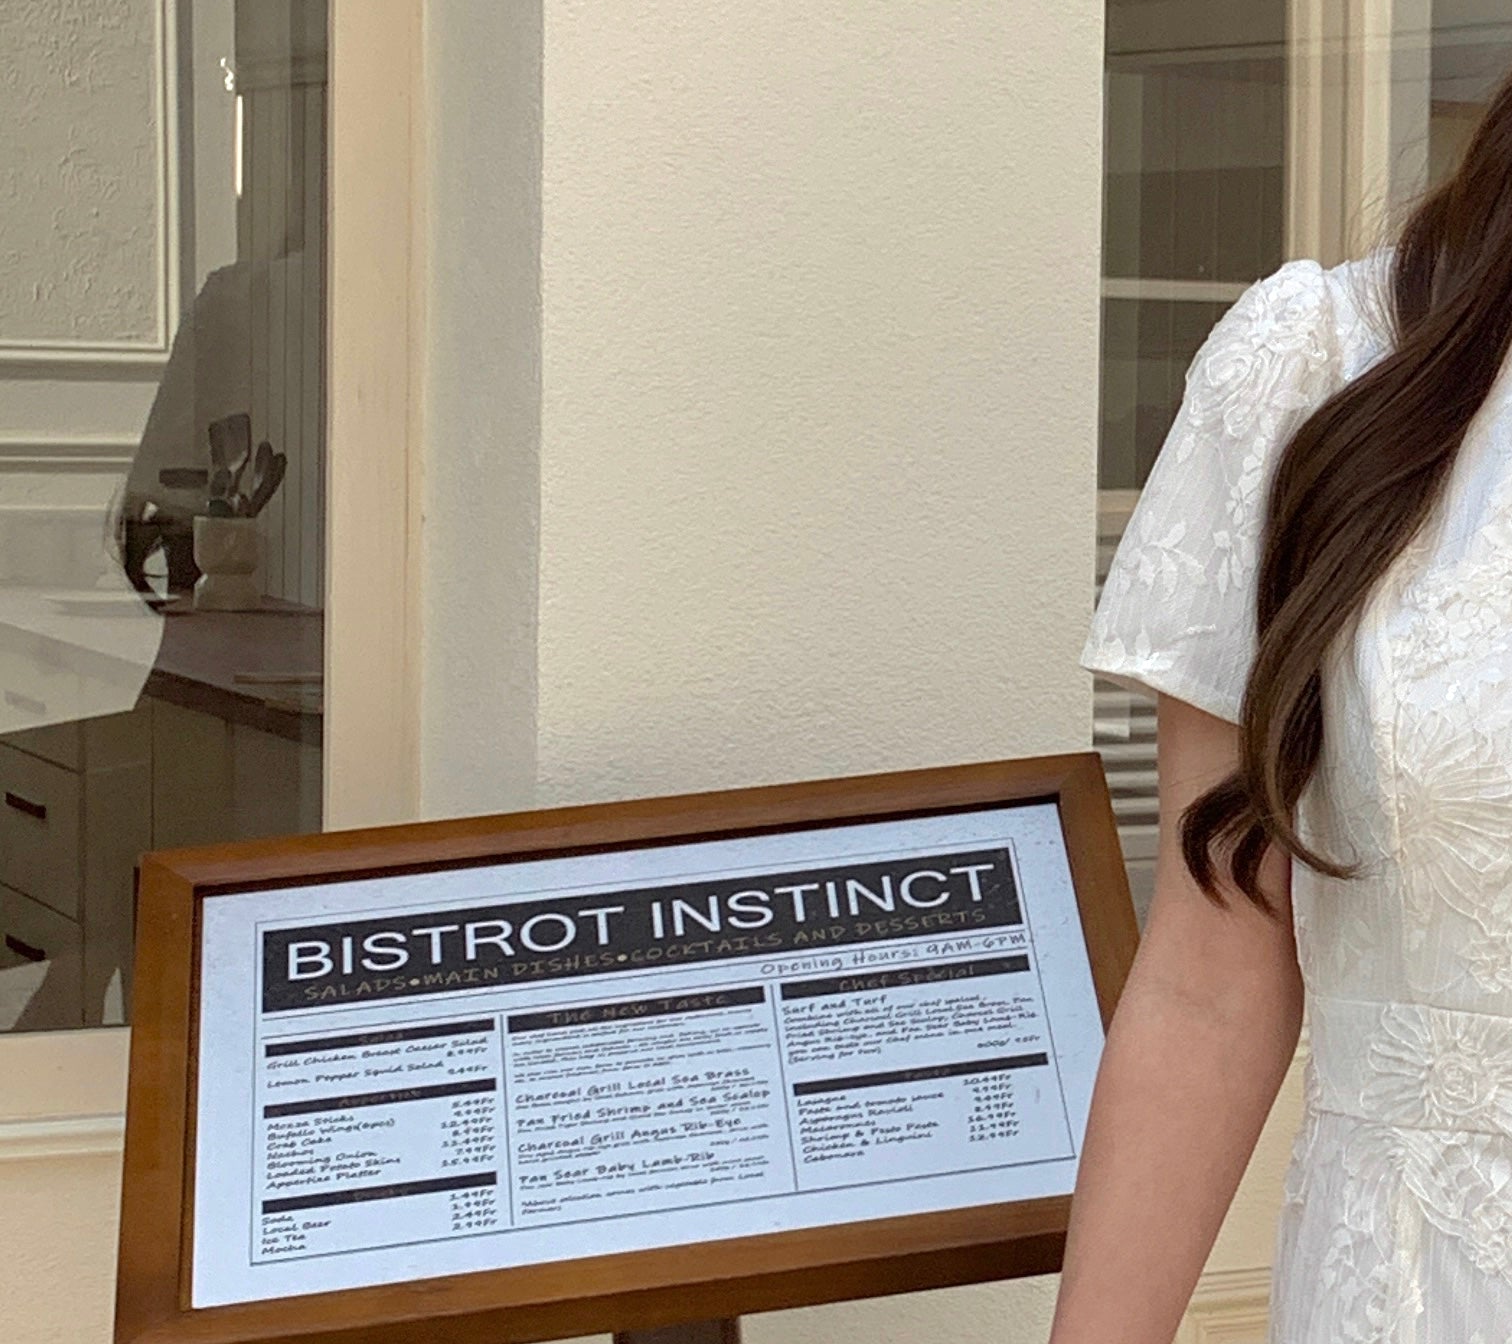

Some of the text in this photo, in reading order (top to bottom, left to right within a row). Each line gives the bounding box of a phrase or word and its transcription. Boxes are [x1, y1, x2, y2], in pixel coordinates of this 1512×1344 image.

[287, 863, 995, 981] BISTROT INSTINCT
[629, 932, 783, 963] COCKTAILS
[793, 923, 847, 944] AND
[855, 908, 987, 936] DESSERTS
[760, 950, 844, 975] Opening
[926, 932, 1028, 955] 9AM-6PM
[837, 964, 975, 991] Chef Special
[545, 992, 727, 1024] The New Taste
[781, 994, 886, 1015] Surf and Turf
[303, 1054, 356, 1065] Chicken
[451, 1036, 487, 1047] Salad
[266, 1060, 443, 1088] Lemon Pepper Squid Salad
[515, 1087, 580, 1103] Charcoal
[587, 1082, 620, 1096] Grill
[628, 1077, 665, 1089] Local
[671, 1074, 698, 1084] Sea
[704, 1068, 749, 1079] Brass
[516, 1118, 544, 1126] Pan
[551, 1109, 590, 1123] Fried
[596, 1105, 650, 1117] Shrimp
[657, 1098, 683, 1109] and
[689, 1096, 716, 1105] Sea
[518, 1136, 583, 1152] Charcoal
[590, 1131, 624, 1144] Grill
[630, 1126, 676, 1139] Angus
[680, 1118, 740, 1131] Rib-Eye
[801, 1132, 849, 1144] Shrimp
[802, 1142, 854, 1153] Chicken
[266, 1166, 315, 1179] Loaded
[365, 1157, 400, 1167] Skins
[267, 1151, 377, 1169] Blooming Onion
[335, 1169, 380, 1179] Platter
[518, 1175, 546, 1183] Pan
[553, 1168, 588, 1179] Sear
[595, 1162, 634, 1174] Baby
[642, 1152, 714, 1168] Lamb-Rib
[262, 1223, 298, 1235] Local
[261, 1244, 306, 1254] Mocha
